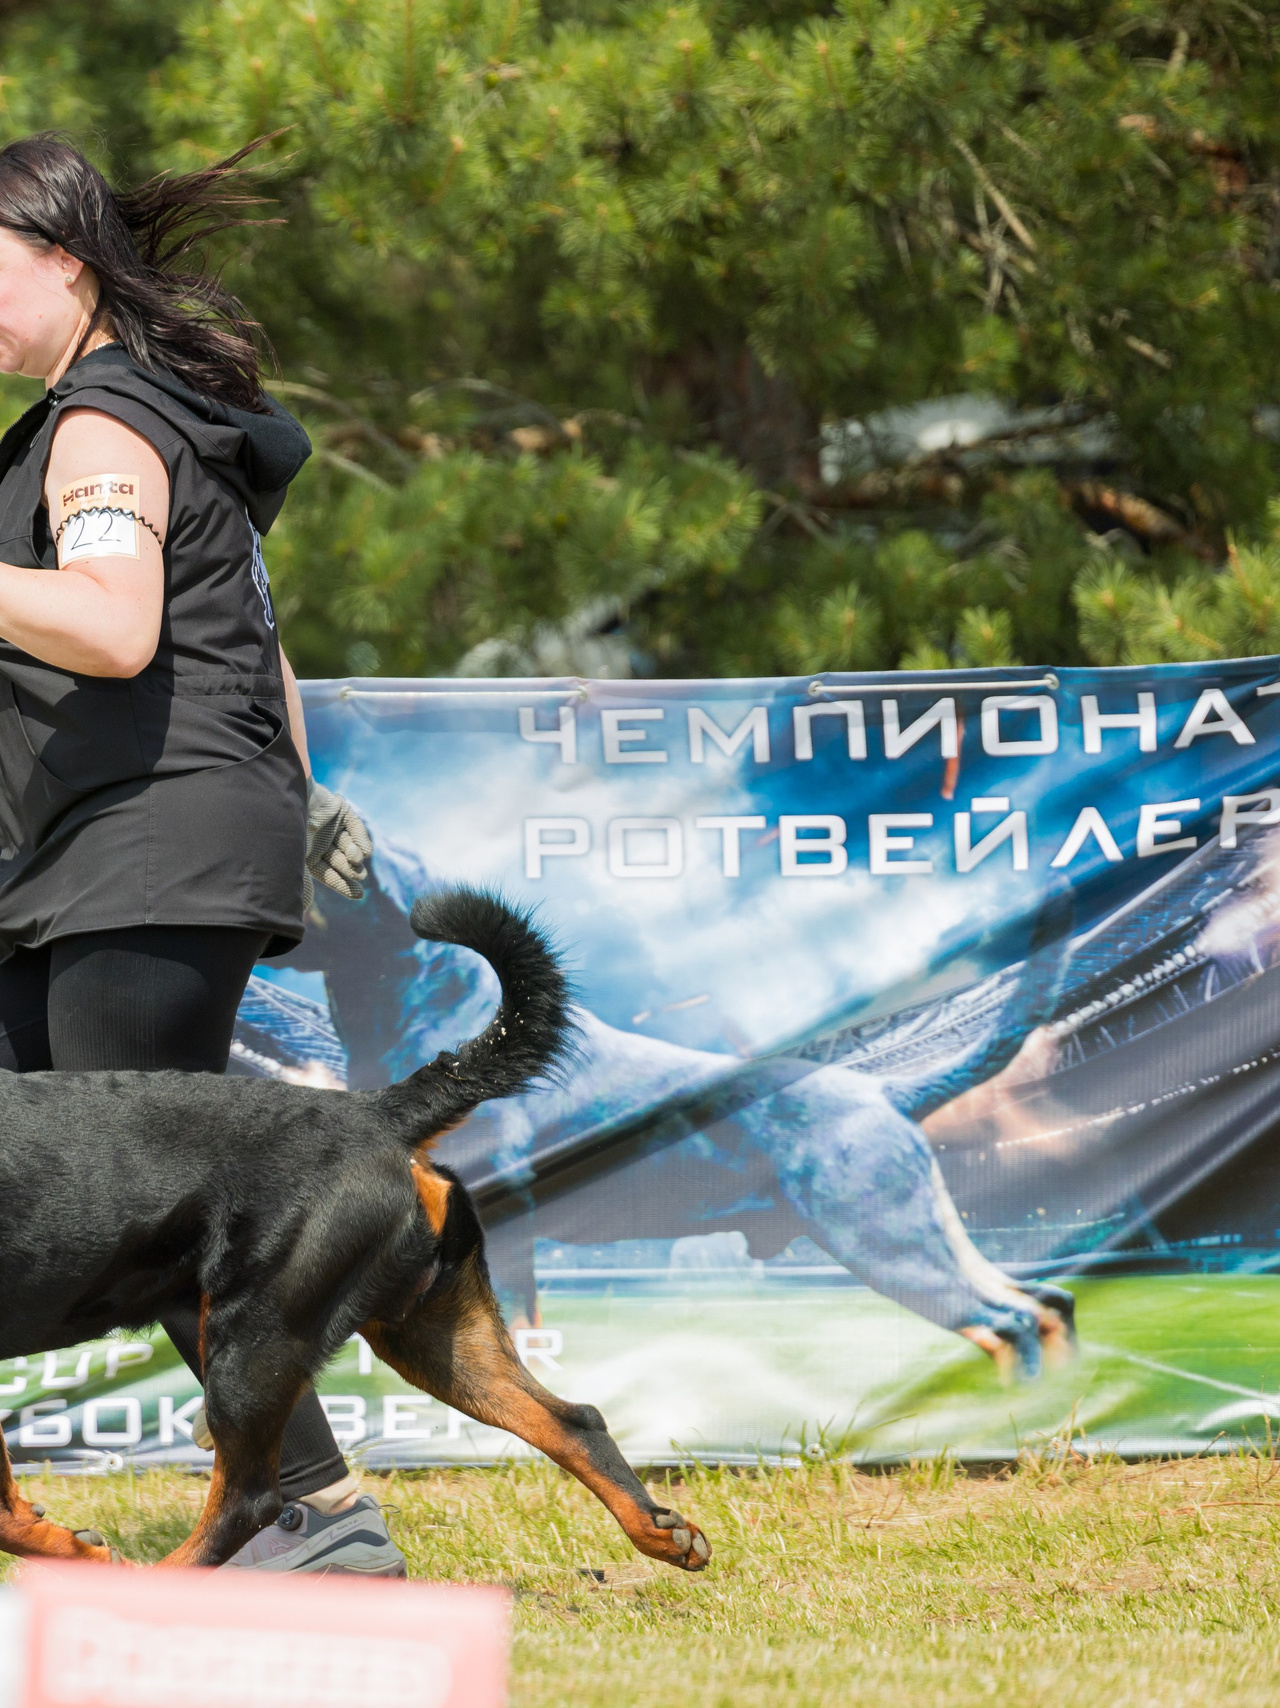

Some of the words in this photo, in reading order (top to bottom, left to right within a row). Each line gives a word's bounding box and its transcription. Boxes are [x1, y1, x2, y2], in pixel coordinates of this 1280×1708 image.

[70, 510, 122, 551] 22
[518, 682, 1280, 764] ЧЕМПИОНА
[524, 788, 1280, 879] РОТВЕЙЛЕР
